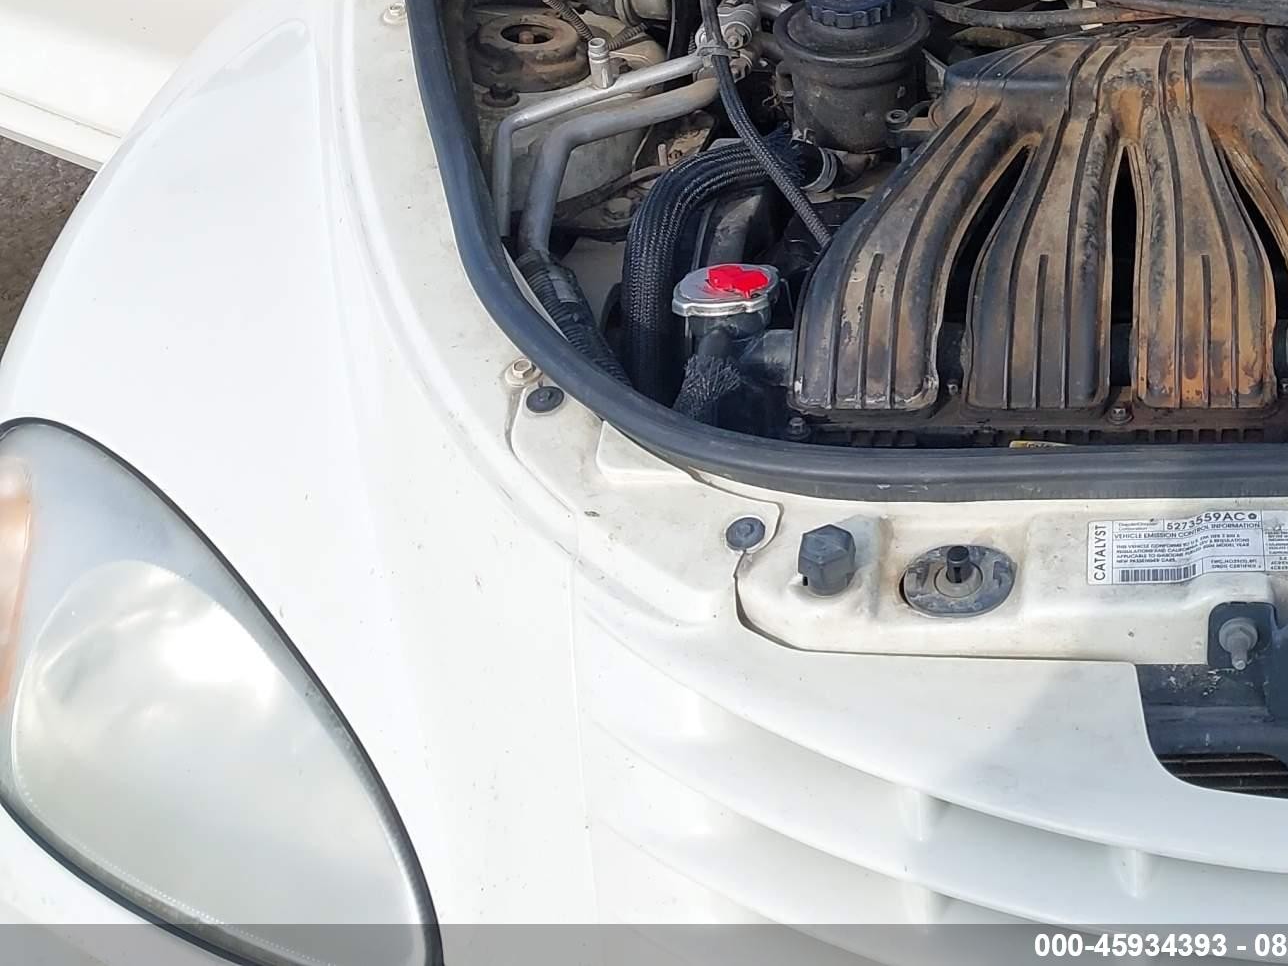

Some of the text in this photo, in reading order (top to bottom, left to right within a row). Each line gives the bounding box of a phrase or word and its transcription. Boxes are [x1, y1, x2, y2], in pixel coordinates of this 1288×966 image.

[1114, 532, 1143, 540] VEHICLE
[1177, 525, 1209, 538] CONTROL
[1210, 522, 1260, 530] INFORMATION
[1166, 512, 1246, 531] 5273559AC
[1093, 524, 1107, 581] CATALYST
